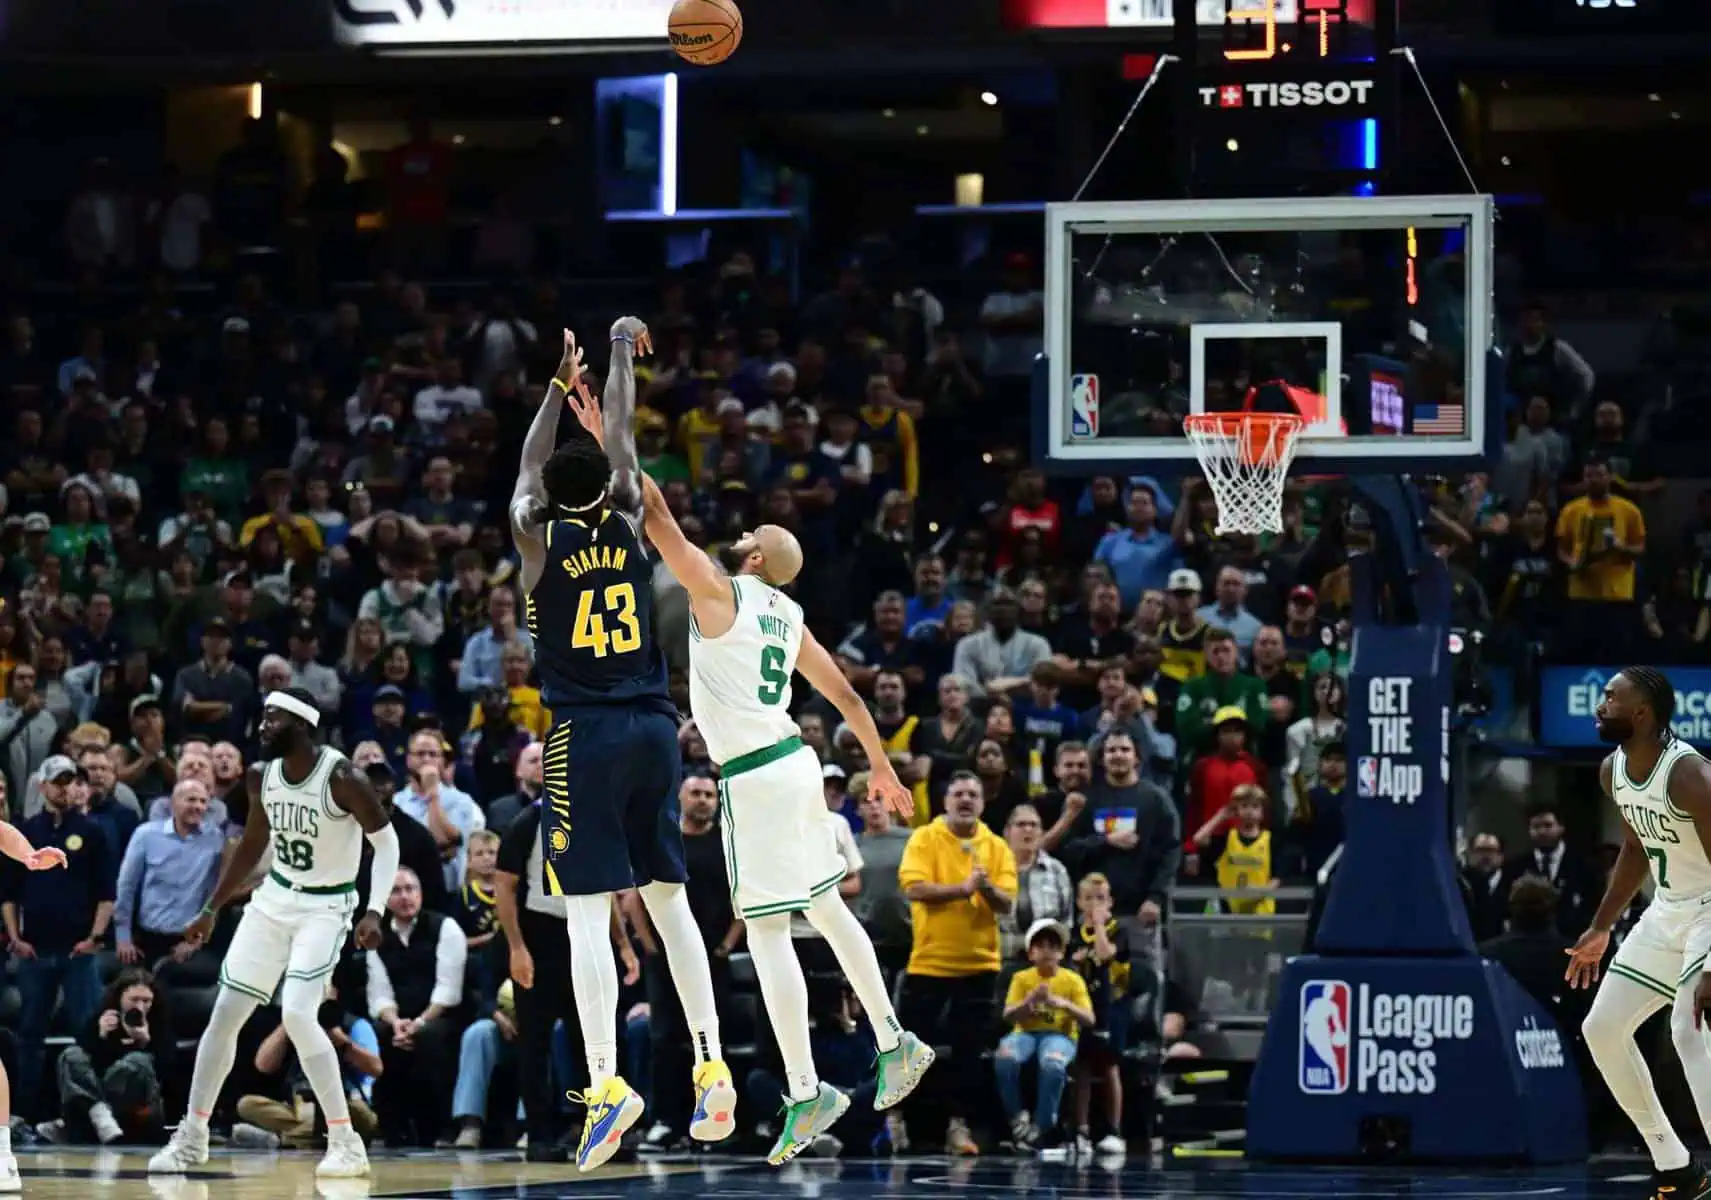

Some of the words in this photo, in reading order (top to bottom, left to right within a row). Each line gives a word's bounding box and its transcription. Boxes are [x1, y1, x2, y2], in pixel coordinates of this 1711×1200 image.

[1245, 80, 1374, 108] TISSOT
[562, 545, 627, 579] SIAKAM
[571, 582, 641, 658] 43
[756, 613, 790, 642] WHITE
[1368, 676, 1412, 715] GET
[1368, 716, 1412, 754] THE
[1378, 757, 1423, 804] App
[1645, 846, 1671, 889] 7
[1358, 983, 1475, 1048] League
[1357, 1038, 1437, 1094] Pass
